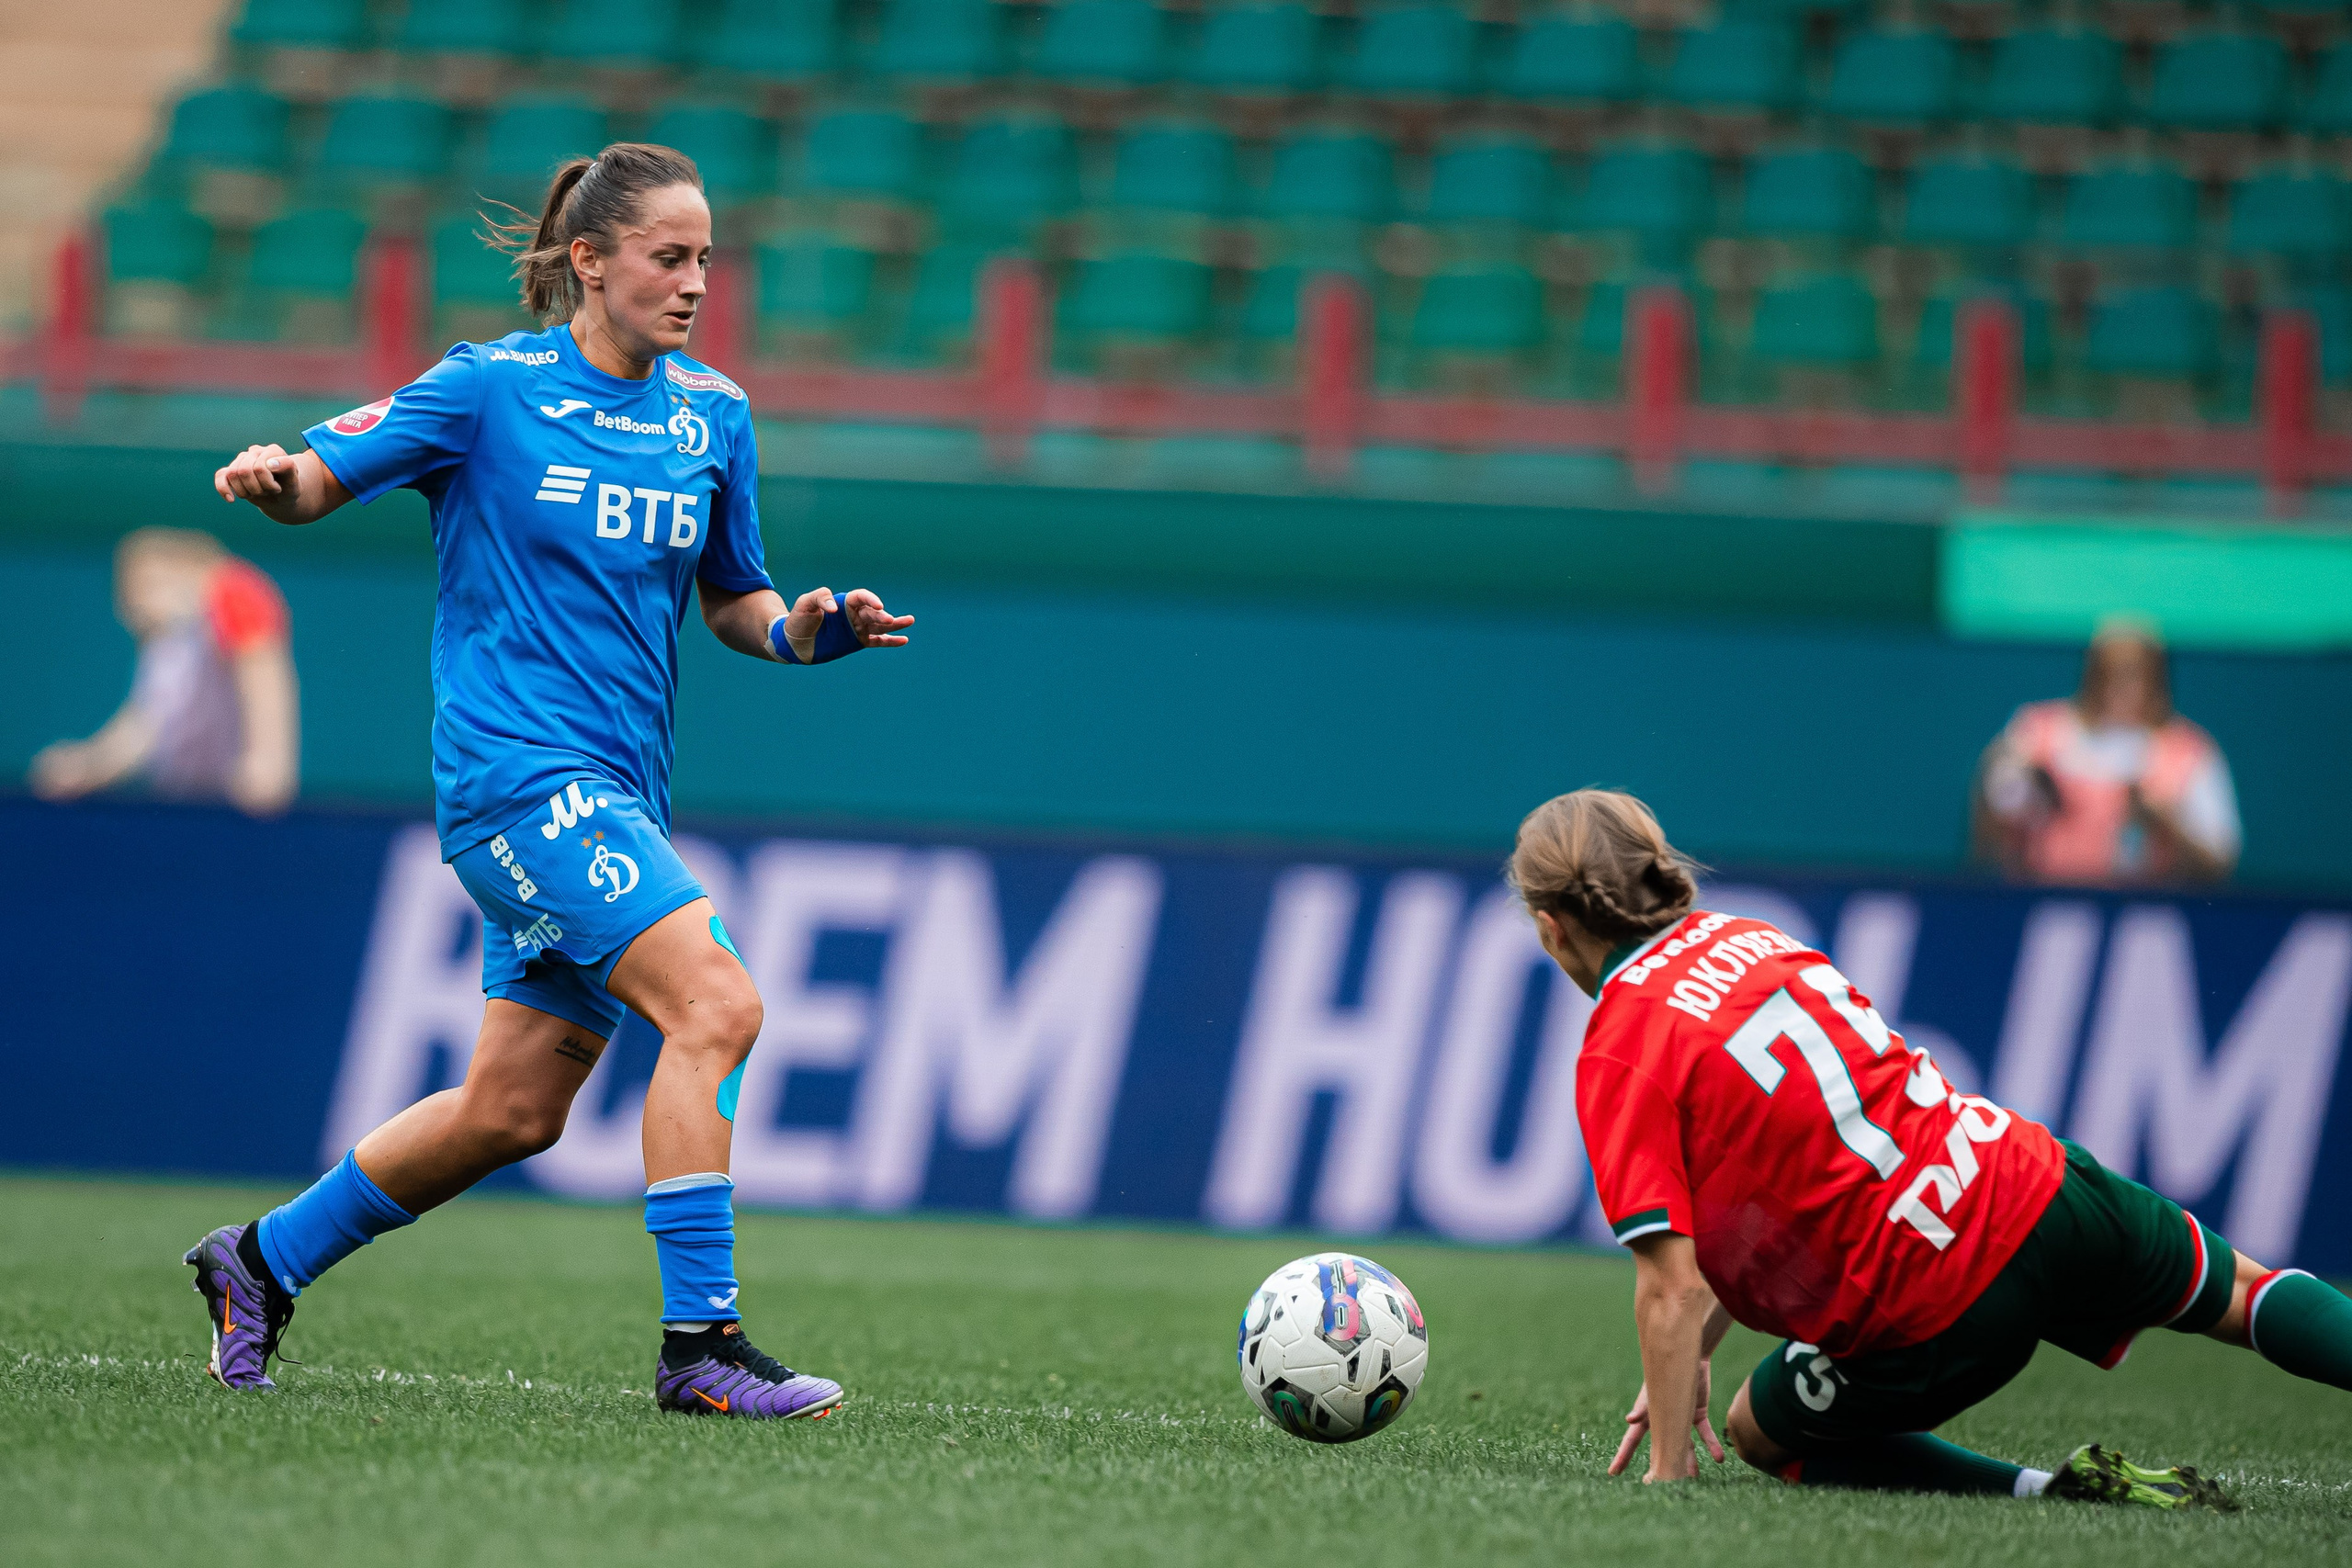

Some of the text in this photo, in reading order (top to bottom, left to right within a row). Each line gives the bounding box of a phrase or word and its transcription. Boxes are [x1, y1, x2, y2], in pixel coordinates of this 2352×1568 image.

[667, 366, 739, 396] wildberries
[341, 417, 364, 429] ЛИГА
[594, 410, 666, 435] BetBoom
[595, 482, 698, 548] ВТБ
[525, 912, 563, 953] ВТБ
